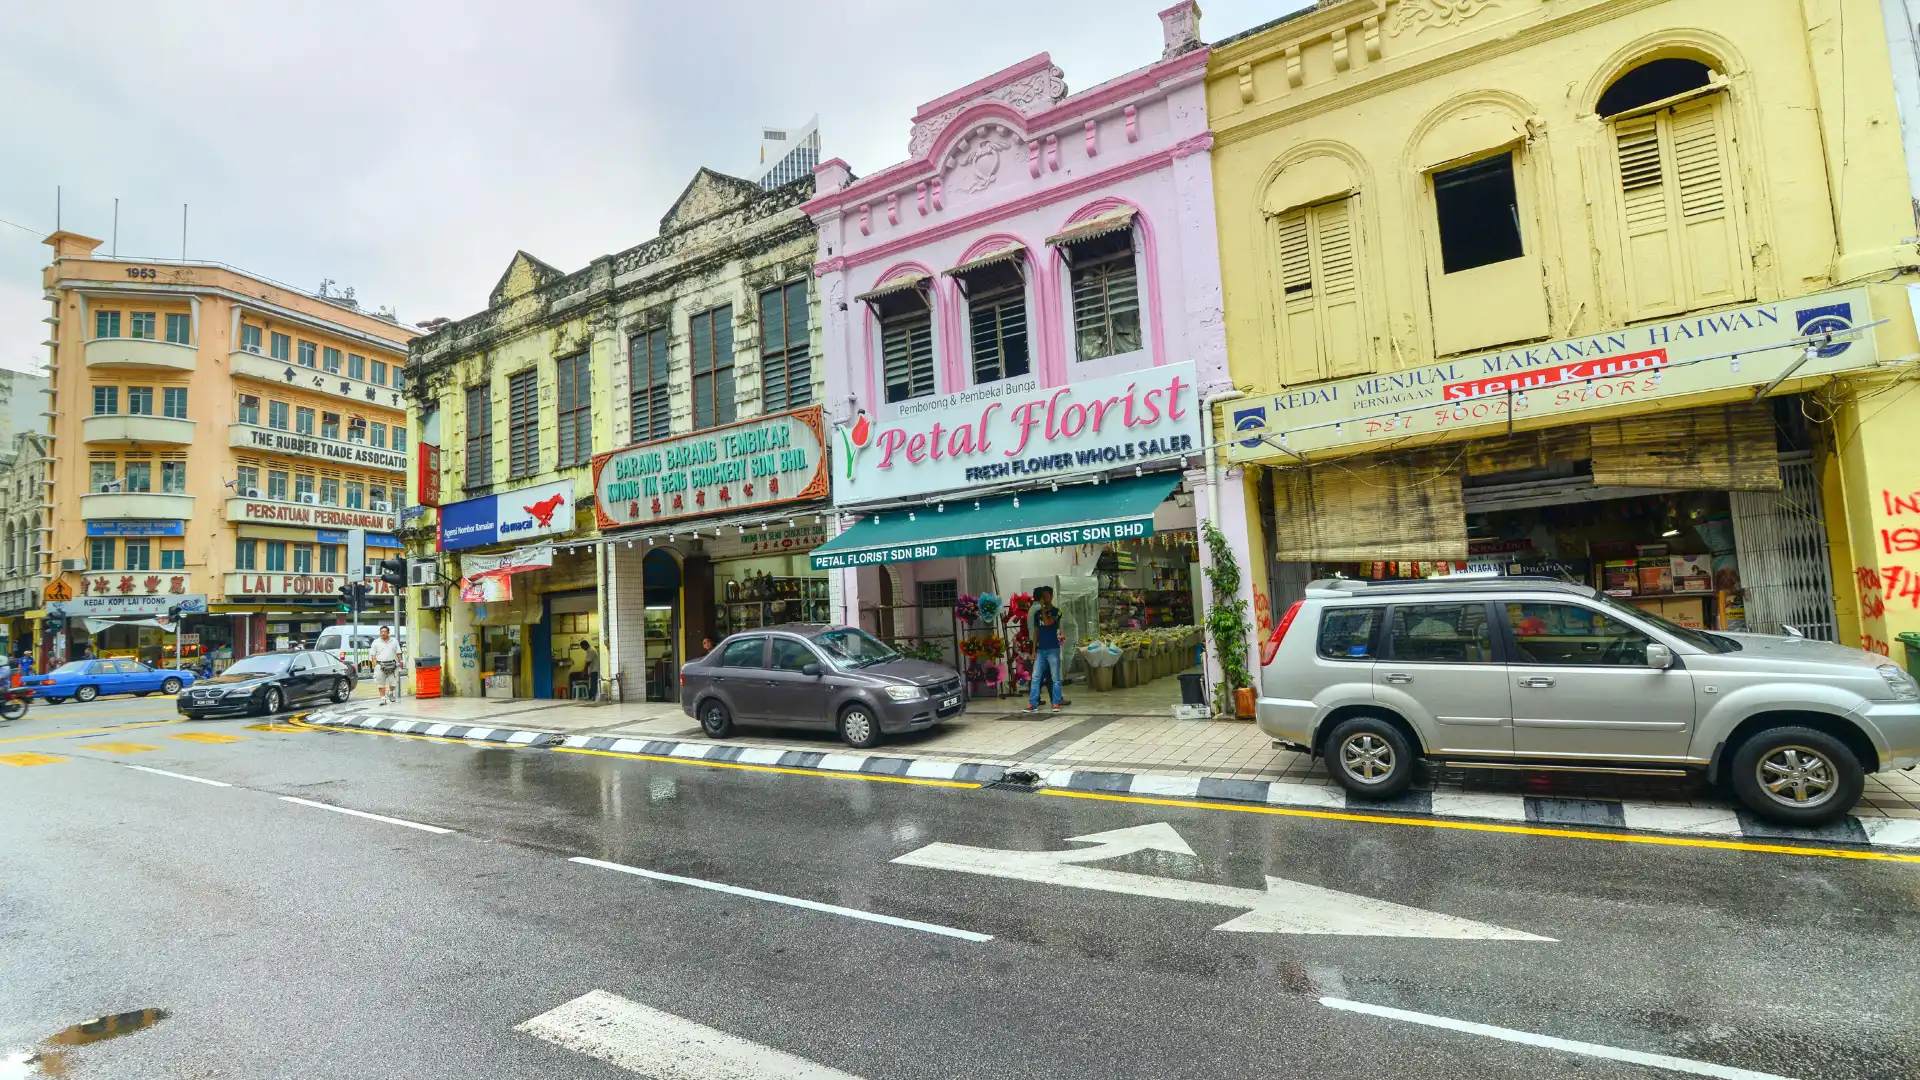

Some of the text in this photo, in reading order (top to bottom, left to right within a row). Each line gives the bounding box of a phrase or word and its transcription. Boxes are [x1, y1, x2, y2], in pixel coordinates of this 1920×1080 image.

[1274, 307, 1779, 412] KEDAI MENJUAL MAKANAN HAIWAN
[899, 379, 1037, 416] Pemborong & Pembekal Bunga
[1353, 387, 1434, 410] PERNIAGAAN
[1365, 416, 1412, 437] PET
[1554, 377, 1662, 407] STORE
[876, 375, 1191, 469] Petal Florist
[252, 430, 274, 447] THE
[276, 435, 318, 454] RUBBER
[320, 443, 352, 460] TRADE
[615, 422, 791, 481] BARANG BARANG TEMBIKAR
[965, 433, 1193, 482] FRESH FLOWER WHOLE SALER
[607, 447, 809, 504] KWONG YIK SENG CROCKERY SDN. BHD.
[246, 502, 310, 523] PERSATUAN
[314, 510, 384, 529] PERDAGANGAN
[985, 522, 1144, 552] PETAL FLORIST SDN BHD
[816, 545, 938, 568] PETAL FLORIST SDN BHD
[242, 575, 271, 594] LAI
[283, 575, 334, 594] FOONG
[84, 597, 166, 607] KEDAI KOPI LAI FOONG
